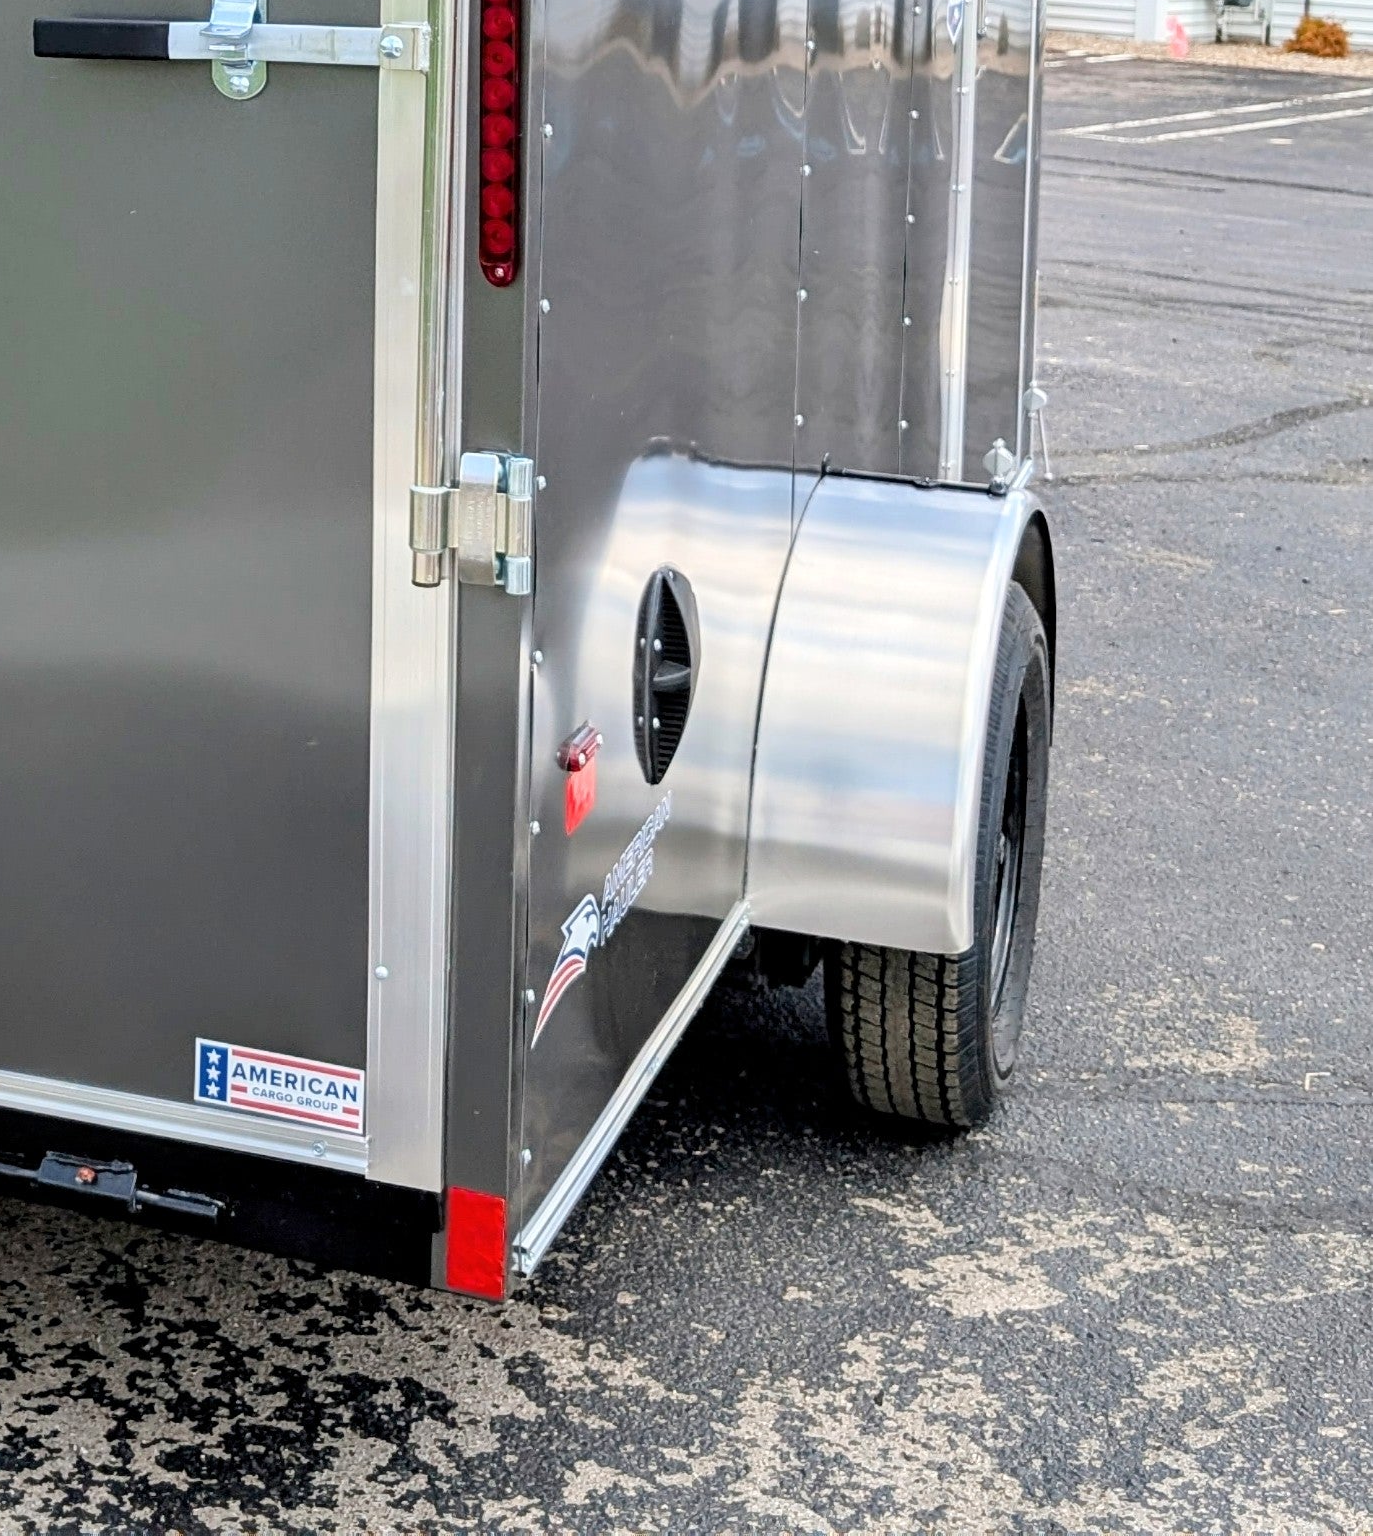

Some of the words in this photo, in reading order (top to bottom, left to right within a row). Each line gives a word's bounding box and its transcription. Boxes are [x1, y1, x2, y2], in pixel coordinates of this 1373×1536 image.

[231, 1062, 358, 1103] AMERICAN
[251, 1086, 294, 1103] CARGO
[296, 1095, 339, 1112] GROUP
